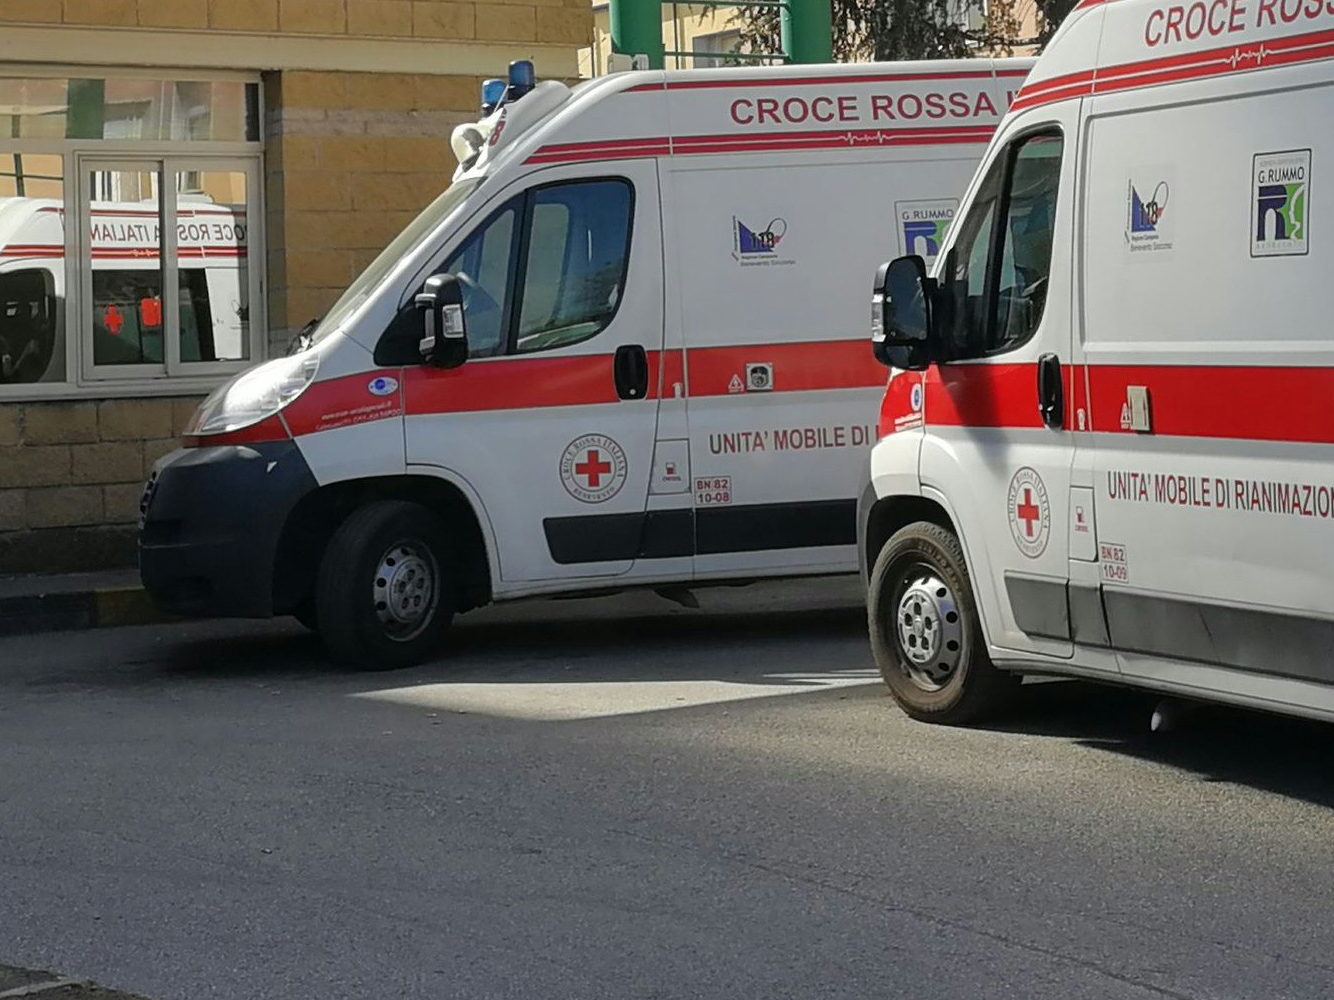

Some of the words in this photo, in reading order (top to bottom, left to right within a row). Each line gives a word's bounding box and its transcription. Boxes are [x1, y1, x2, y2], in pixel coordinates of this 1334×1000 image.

[730, 96, 860, 125] CROCE
[871, 91, 998, 121] ROSSA
[708, 431, 768, 455] UNITA'
[774, 427, 845, 450] MOBILE
[852, 425, 870, 447] DI
[697, 481, 711, 490] BN
[714, 479, 729, 489] 82
[1108, 471, 1152, 501] UNITA'
[1155, 474, 1211, 507] MOBILE
[1215, 478, 1231, 509] DI
[698, 492, 730, 503] 10-08
[1101, 546, 1113, 561] BN
[1114, 547, 1125, 562] 82
[1103, 564, 1128, 581] 10-09
